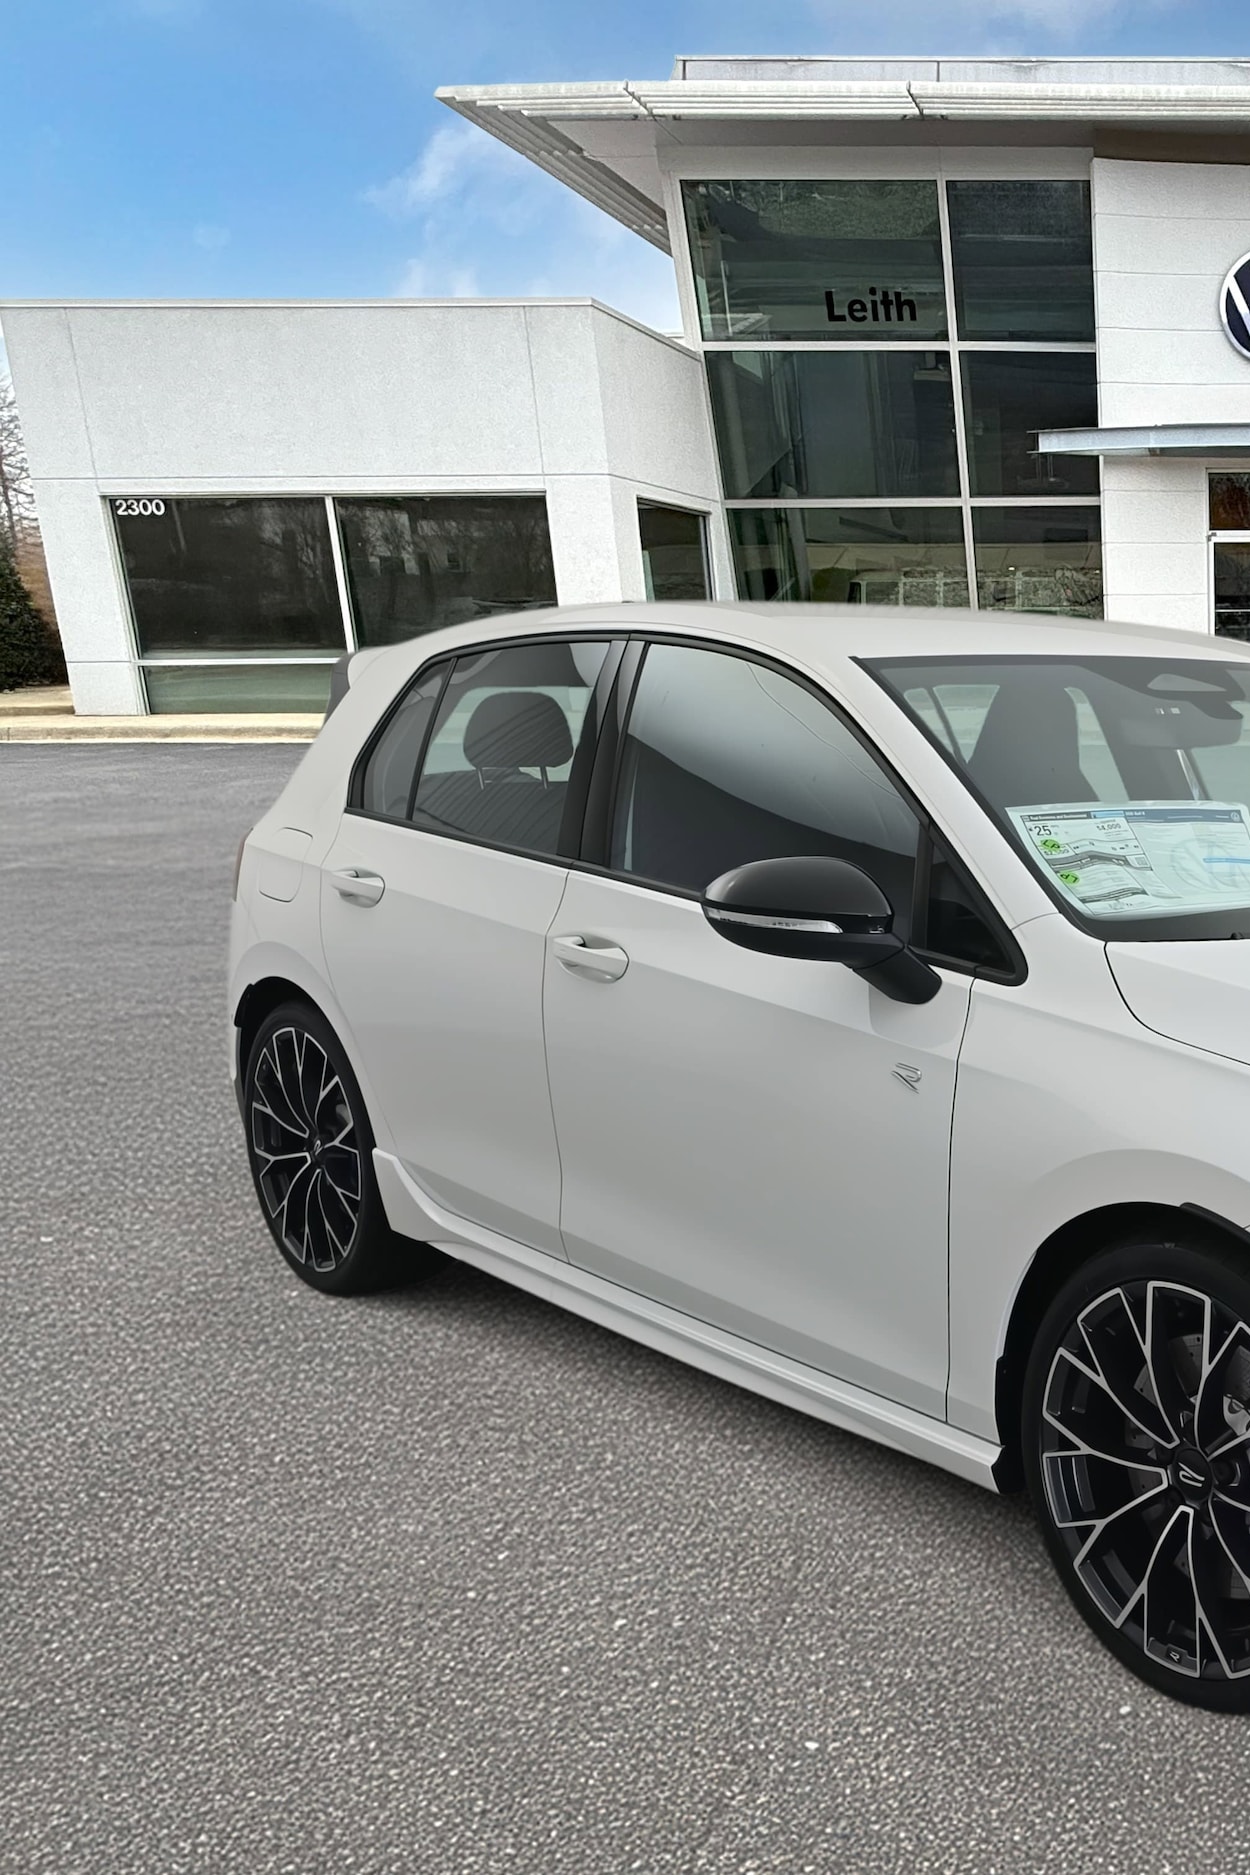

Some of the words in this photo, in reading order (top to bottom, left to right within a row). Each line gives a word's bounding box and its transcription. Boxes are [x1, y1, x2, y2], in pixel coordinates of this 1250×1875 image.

[825, 287, 917, 322] Leith
[115, 499, 166, 516] 2300
[1034, 825, 1052, 837] 25
